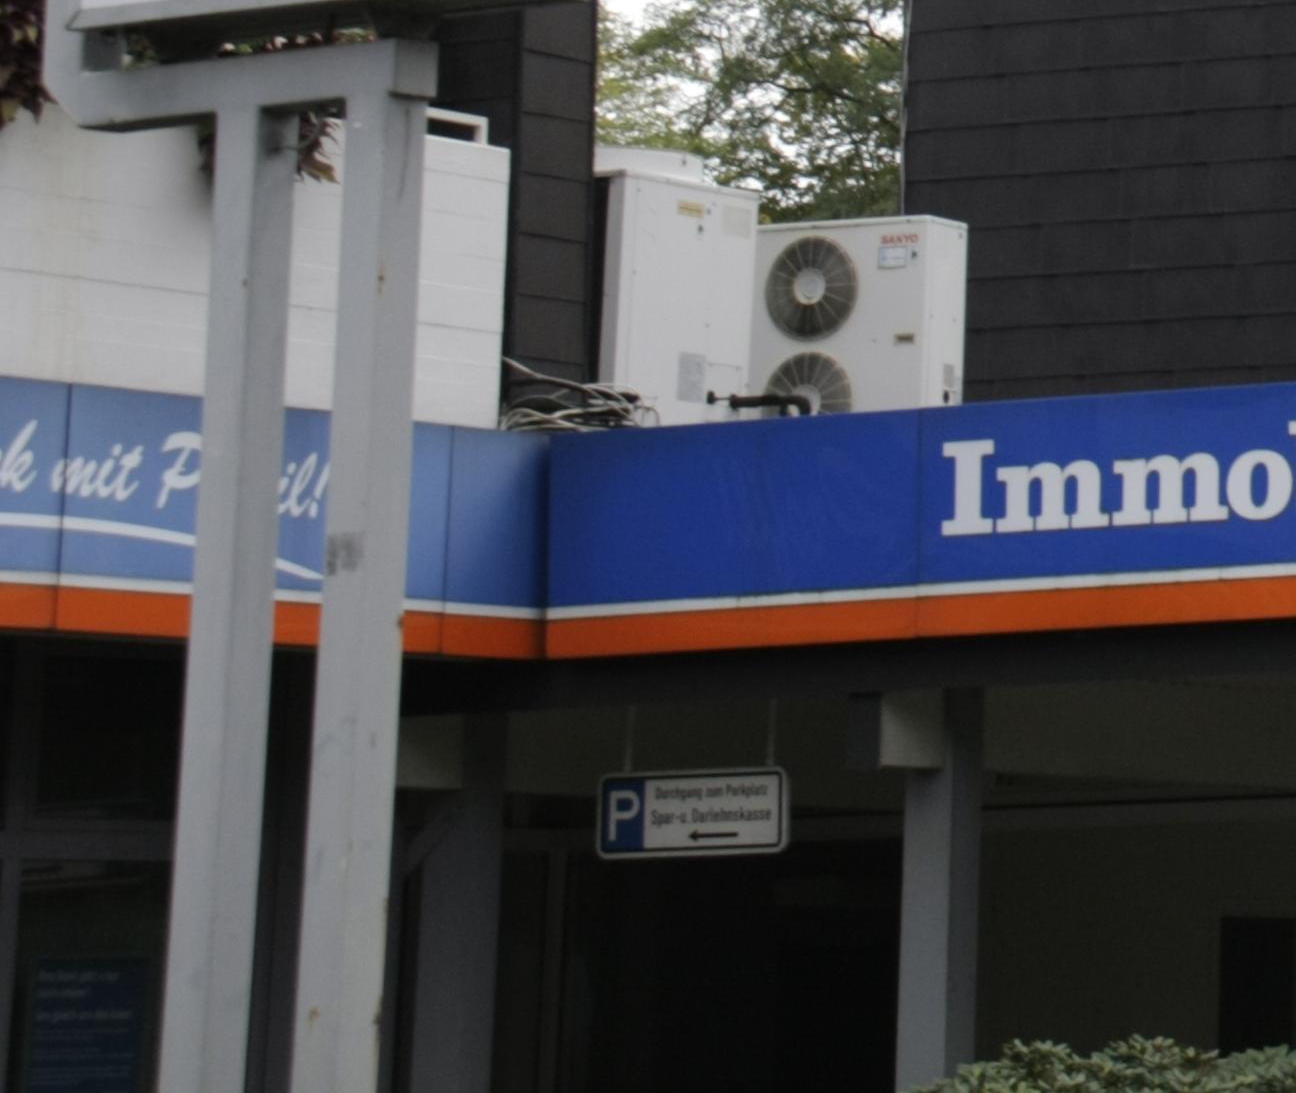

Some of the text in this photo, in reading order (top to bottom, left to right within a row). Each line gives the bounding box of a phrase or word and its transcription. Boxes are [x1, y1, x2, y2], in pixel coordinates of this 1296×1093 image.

[50, 442, 144, 502] mit
[726, 783, 769, 800] Parkplatz
[608, 789, 640, 842] P
[692, 805, 772, 824] Darlehnskasse
